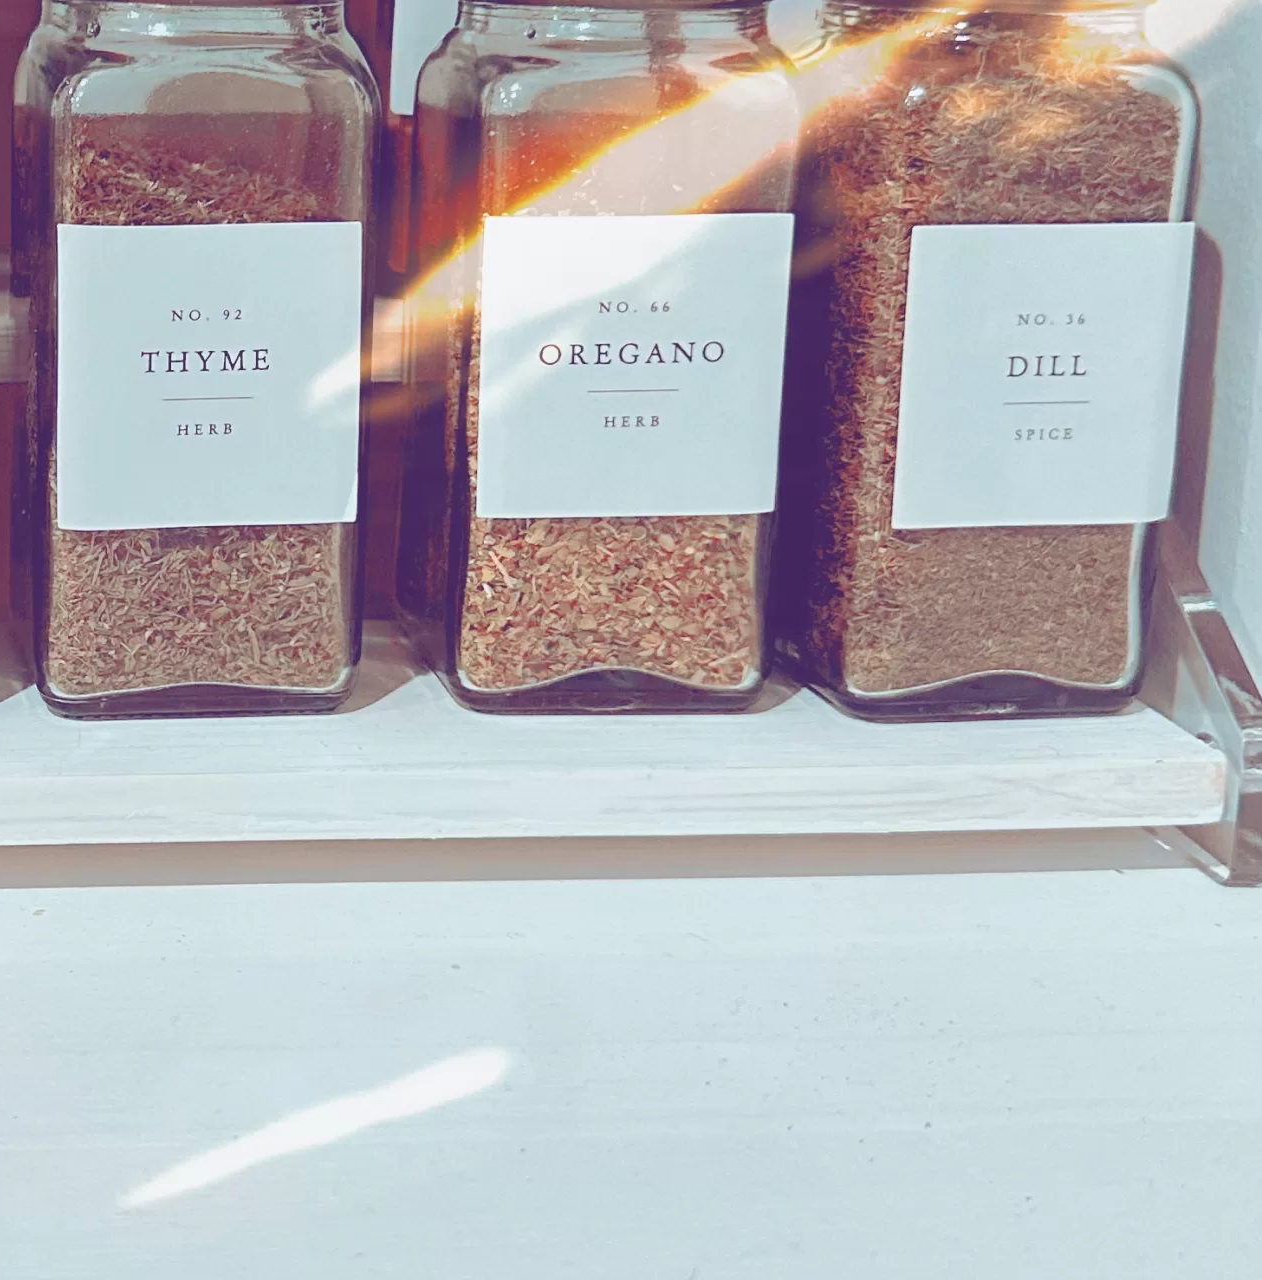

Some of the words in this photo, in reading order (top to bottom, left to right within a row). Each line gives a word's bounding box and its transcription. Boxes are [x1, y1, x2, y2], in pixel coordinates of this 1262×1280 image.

[598, 300, 638, 314] NO.
[650, 301, 671, 314] 66
[171, 308, 210, 323] NO.
[222, 308, 243, 321] 92
[1017, 313, 1055, 327] NO.
[1065, 313, 1086, 326] 36
[538, 340, 725, 366] OREGANO
[140, 348, 270, 374] THYME
[1005, 354, 1088, 378] DILL
[176, 422, 233, 437] HERB
[603, 415, 660, 429] HERB
[1014, 427, 1074, 441] SPICE
